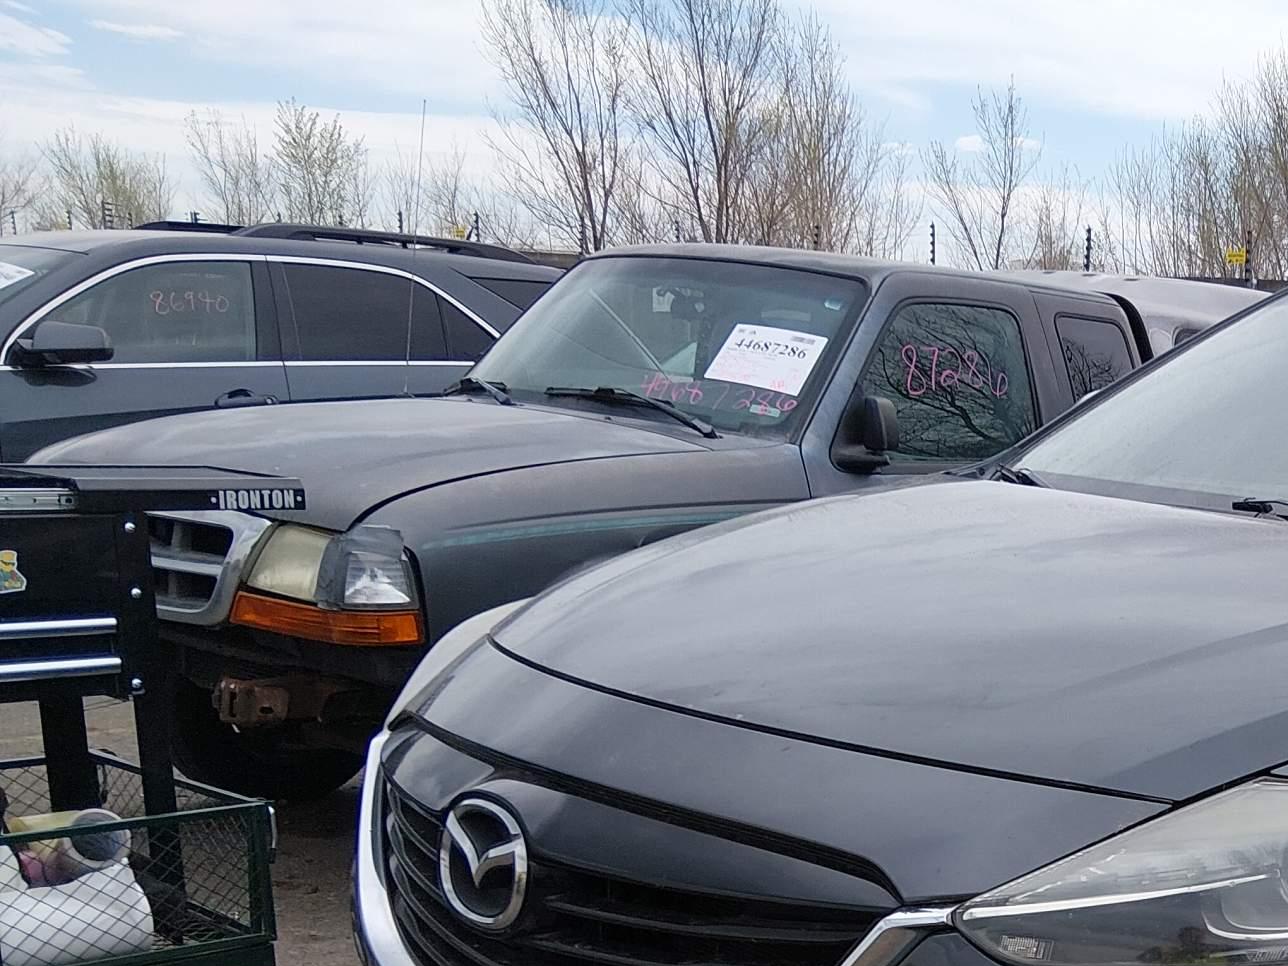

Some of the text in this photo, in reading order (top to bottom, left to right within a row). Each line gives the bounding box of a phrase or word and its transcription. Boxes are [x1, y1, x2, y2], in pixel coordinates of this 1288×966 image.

[735, 337, 807, 361] 44687286
[902, 343, 1008, 400] 87286
[218, 489, 296, 510] IRONTON
